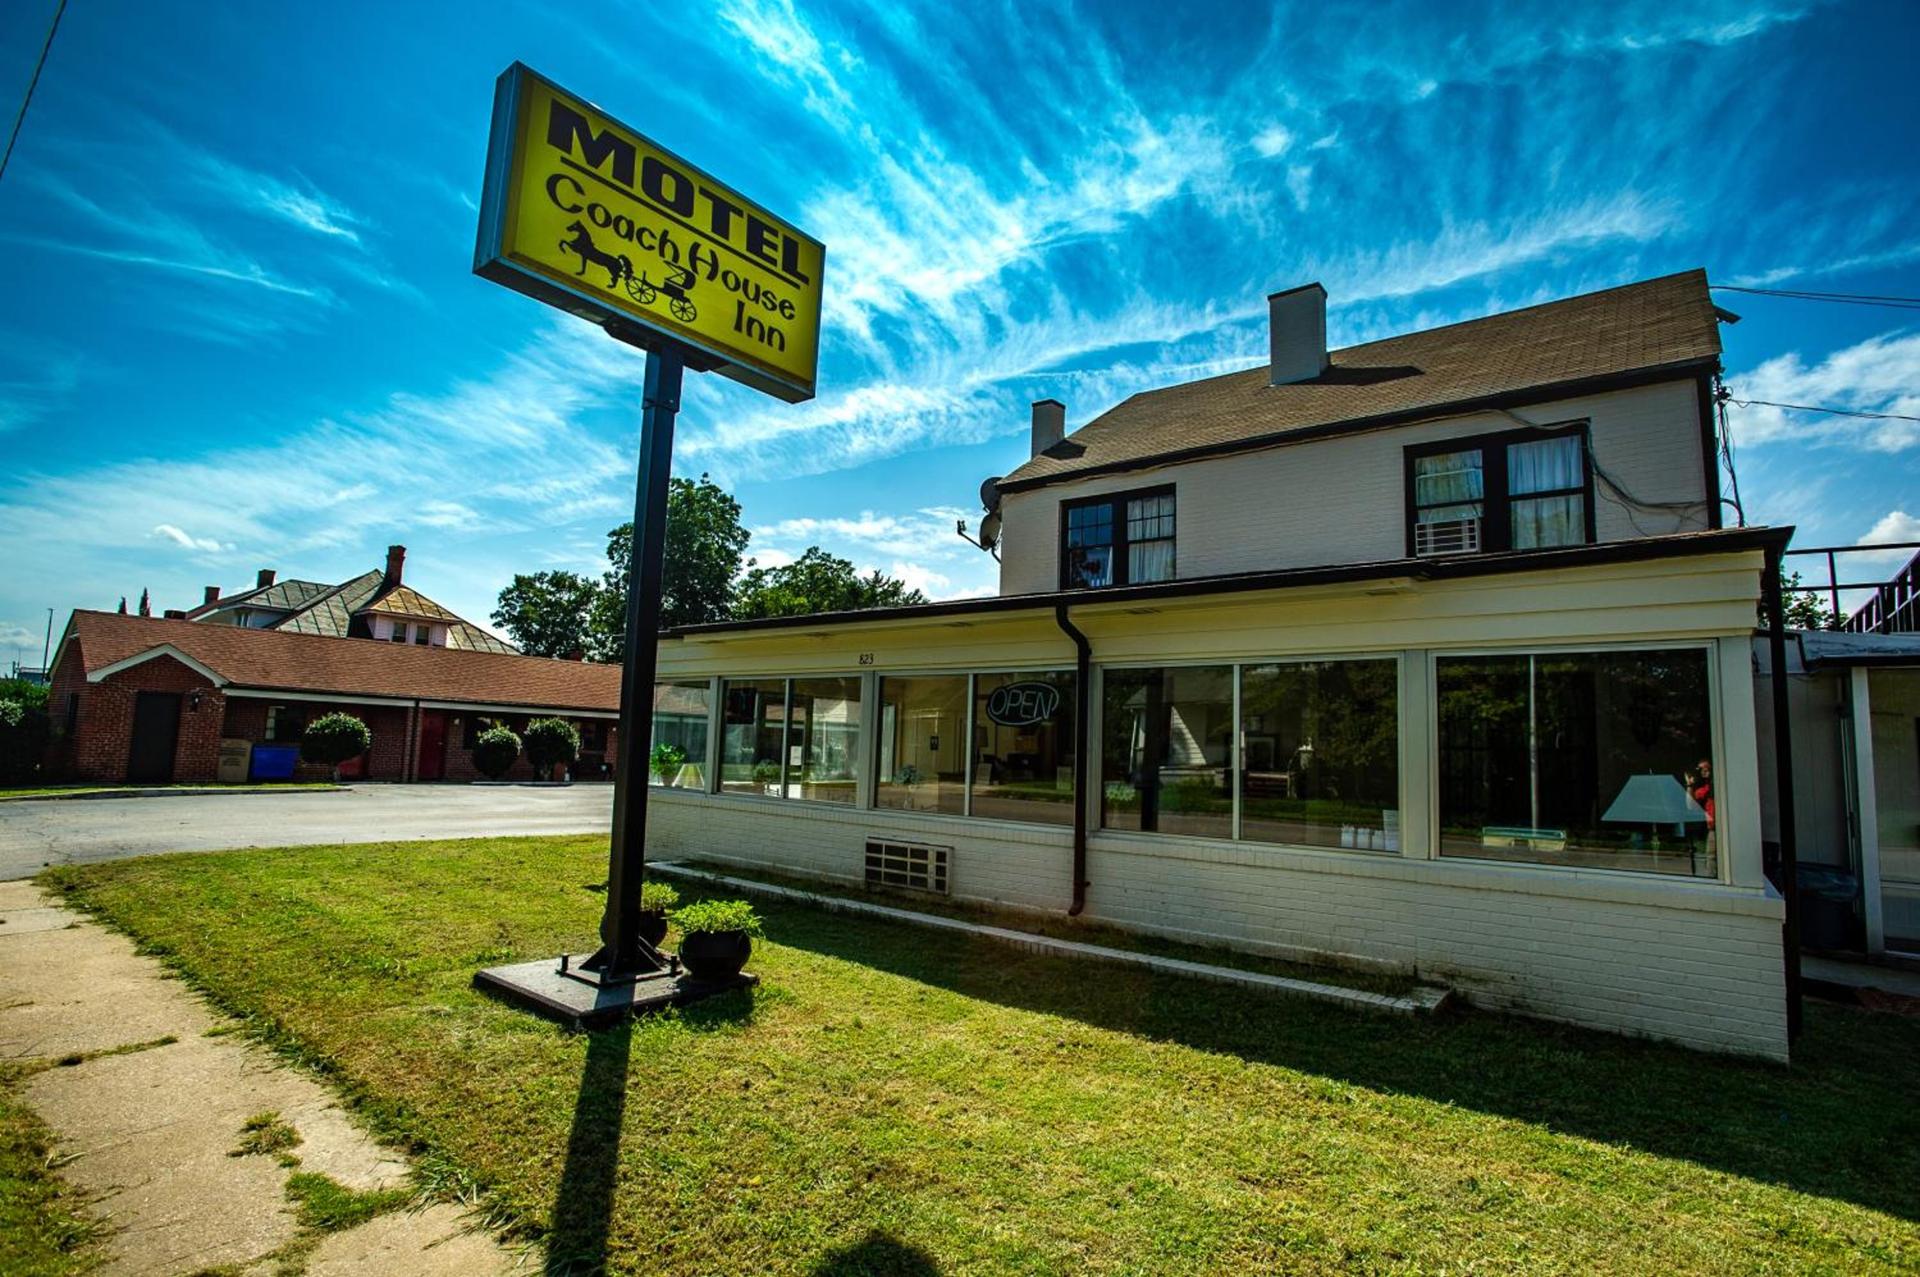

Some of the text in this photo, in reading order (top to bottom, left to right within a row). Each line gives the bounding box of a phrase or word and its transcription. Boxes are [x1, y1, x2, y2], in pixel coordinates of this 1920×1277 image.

[547, 98, 810, 287] MOTEL
[545, 173, 796, 321] Coach House
[733, 301, 786, 353] Inn
[858, 653, 874, 665] 823
[990, 688, 1054, 720] OPEN
